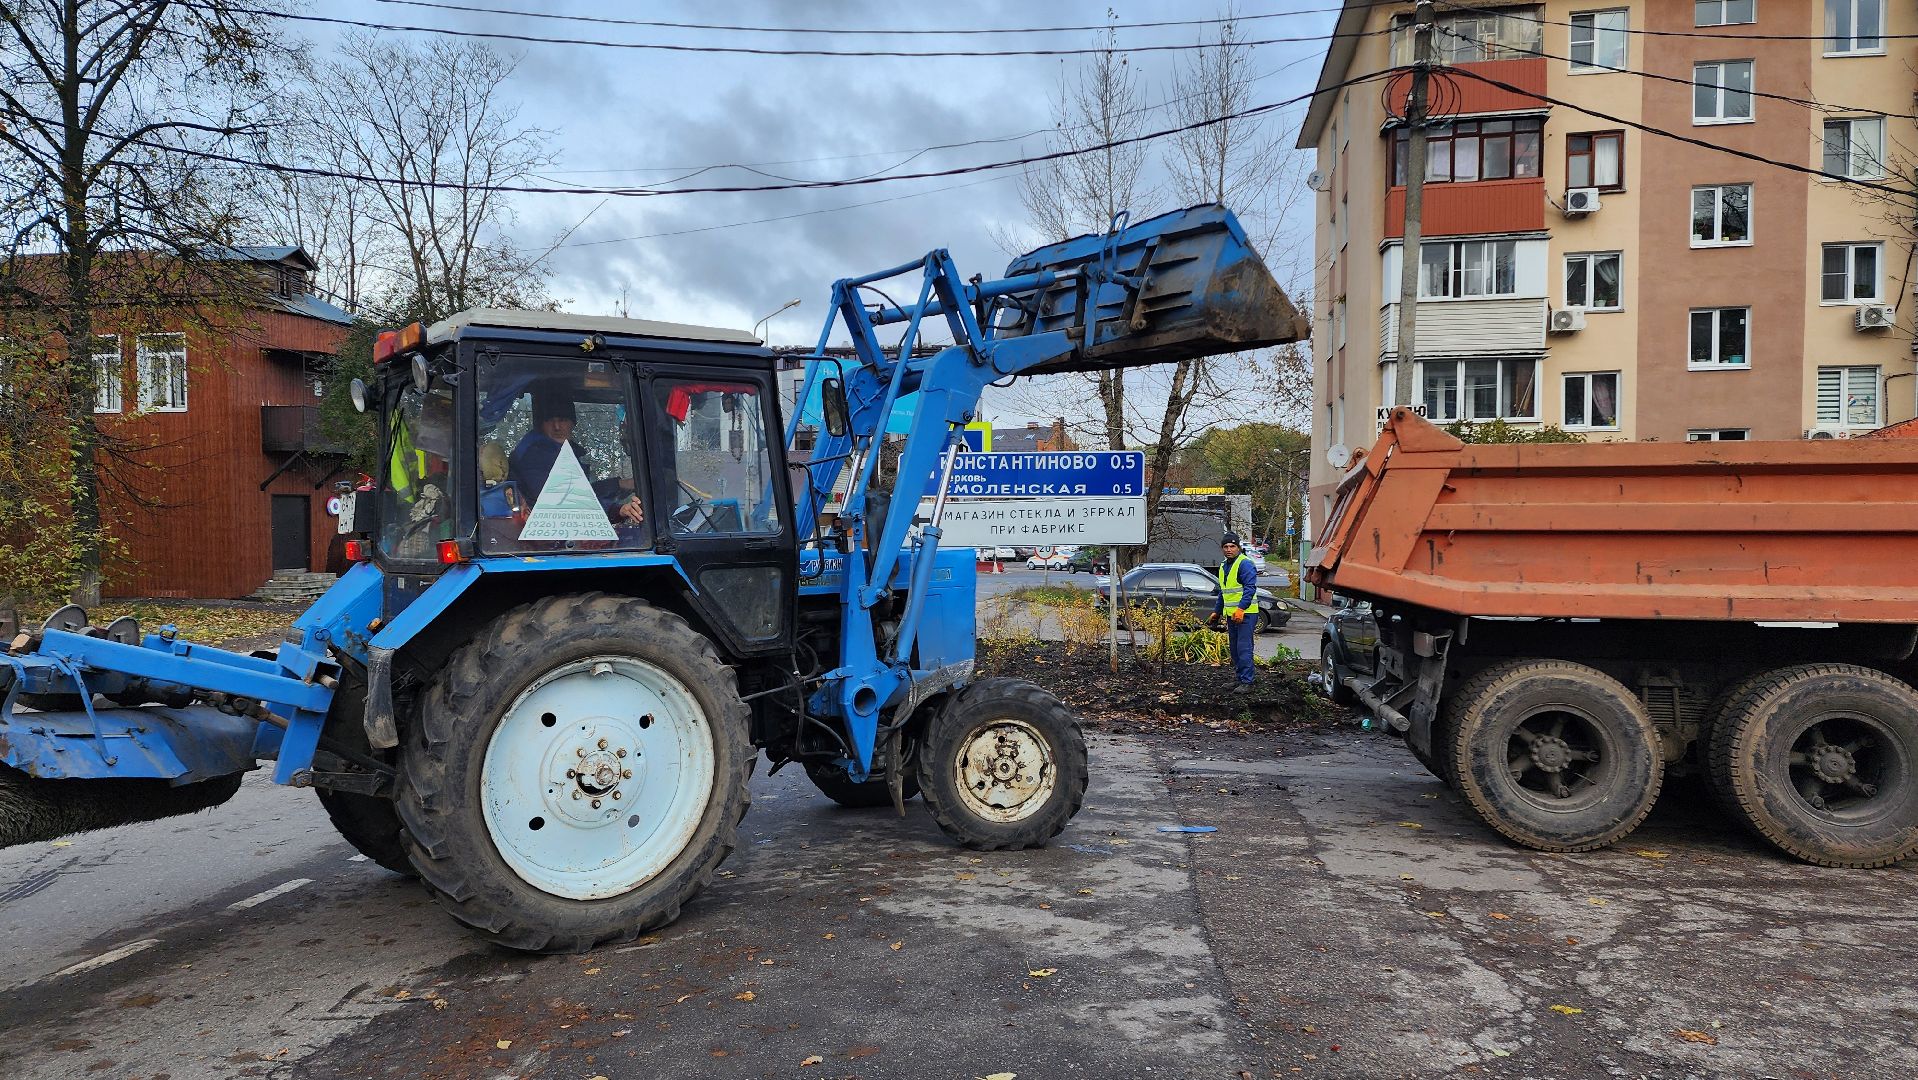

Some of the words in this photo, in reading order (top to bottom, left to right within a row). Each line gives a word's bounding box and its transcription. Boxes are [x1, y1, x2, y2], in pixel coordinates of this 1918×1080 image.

[1378, 406, 1427, 419] КУЮ
[1110, 455, 1136, 471] 0,5
[945, 510, 1004, 521] МАГАЗИН
[1010, 508, 1062, 519] СТЕКЛА
[1067, 508, 1075, 518] И
[528, 521, 556, 529] (926)
[560, 521, 609, 529] 903-15-25
[991, 525, 1015, 535] ПРИ
[1021, 523, 1085, 534] ФАБРИКЕ
[524, 529, 569, 539] (49679)
[574, 529, 614, 538] 7-40-50
